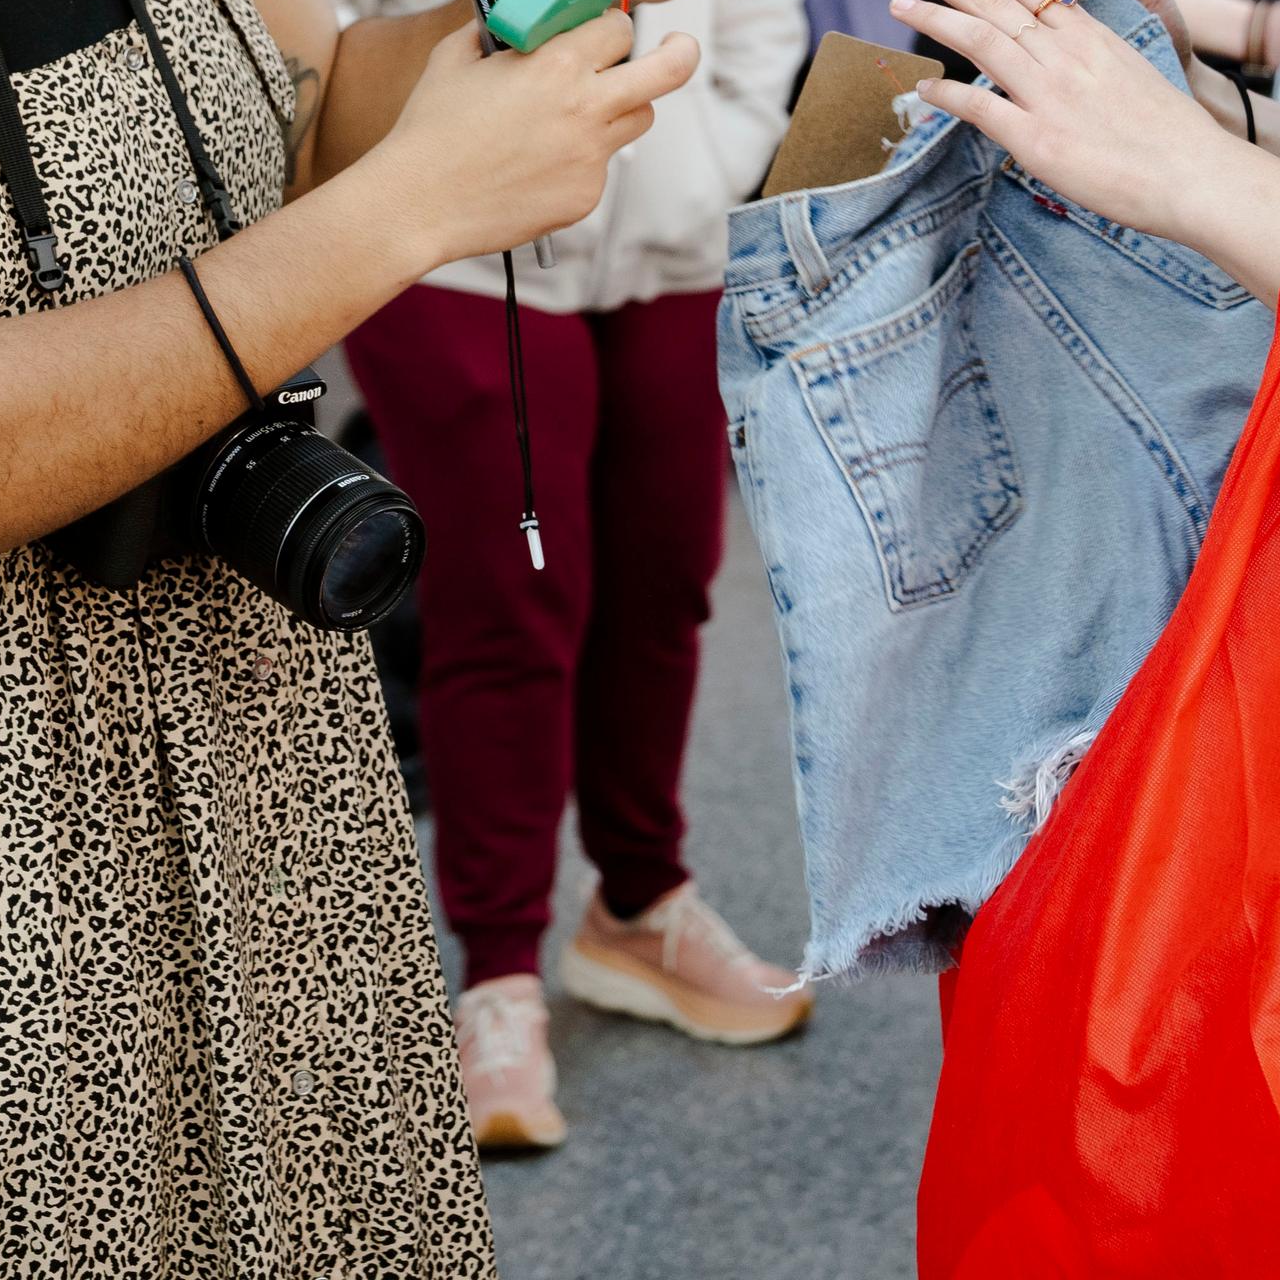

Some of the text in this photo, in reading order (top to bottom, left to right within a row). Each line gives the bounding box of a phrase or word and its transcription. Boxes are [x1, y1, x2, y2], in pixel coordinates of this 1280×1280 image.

[278, 386, 322, 405] Canon
[225, 445, 242, 463] IMAGE
[246, 459, 257, 470] 55
[338, 474, 370, 488] Canon
